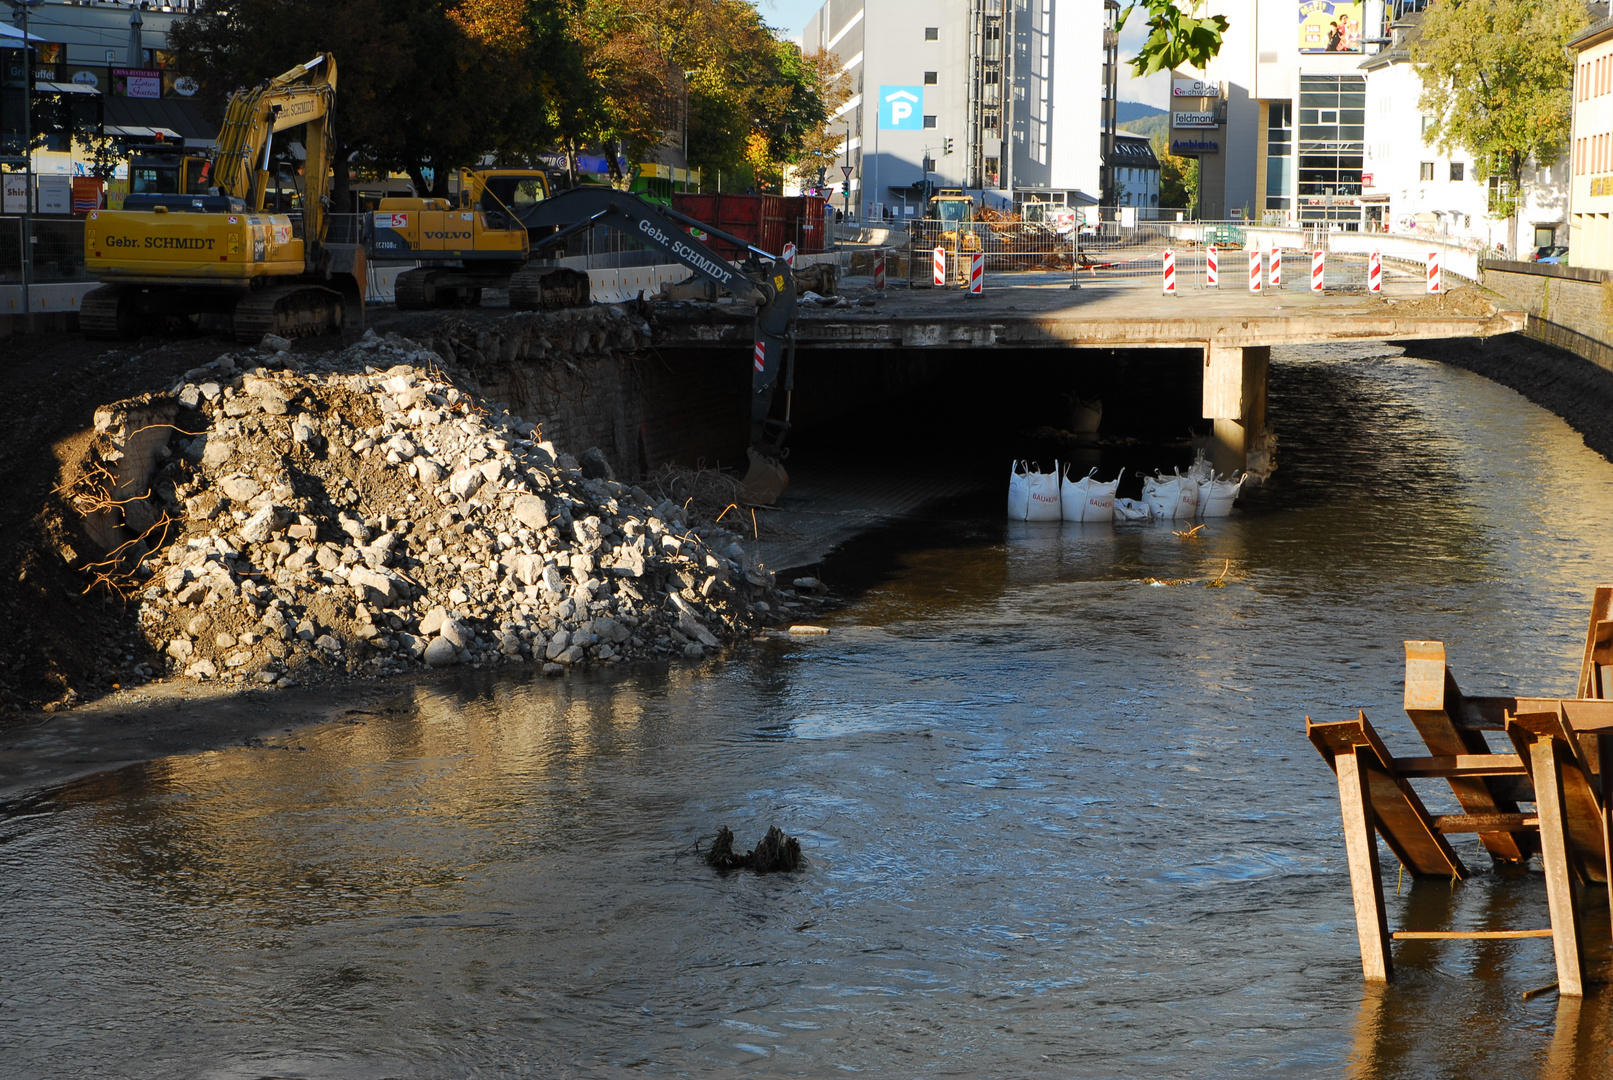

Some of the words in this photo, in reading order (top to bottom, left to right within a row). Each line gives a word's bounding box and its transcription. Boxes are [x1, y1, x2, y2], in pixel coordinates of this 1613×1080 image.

[291, 100, 314, 116] SCHMIDT
[892, 101, 913, 125] P
[1173, 139, 1218, 149] Ambiente
[423, 231, 472, 239] VOLVO
[106, 236, 141, 248] Gebr.
[144, 237, 215, 250] SCHMIDT
[638, 219, 670, 247] Gebr.
[671, 241, 733, 284] SCHMIDT
